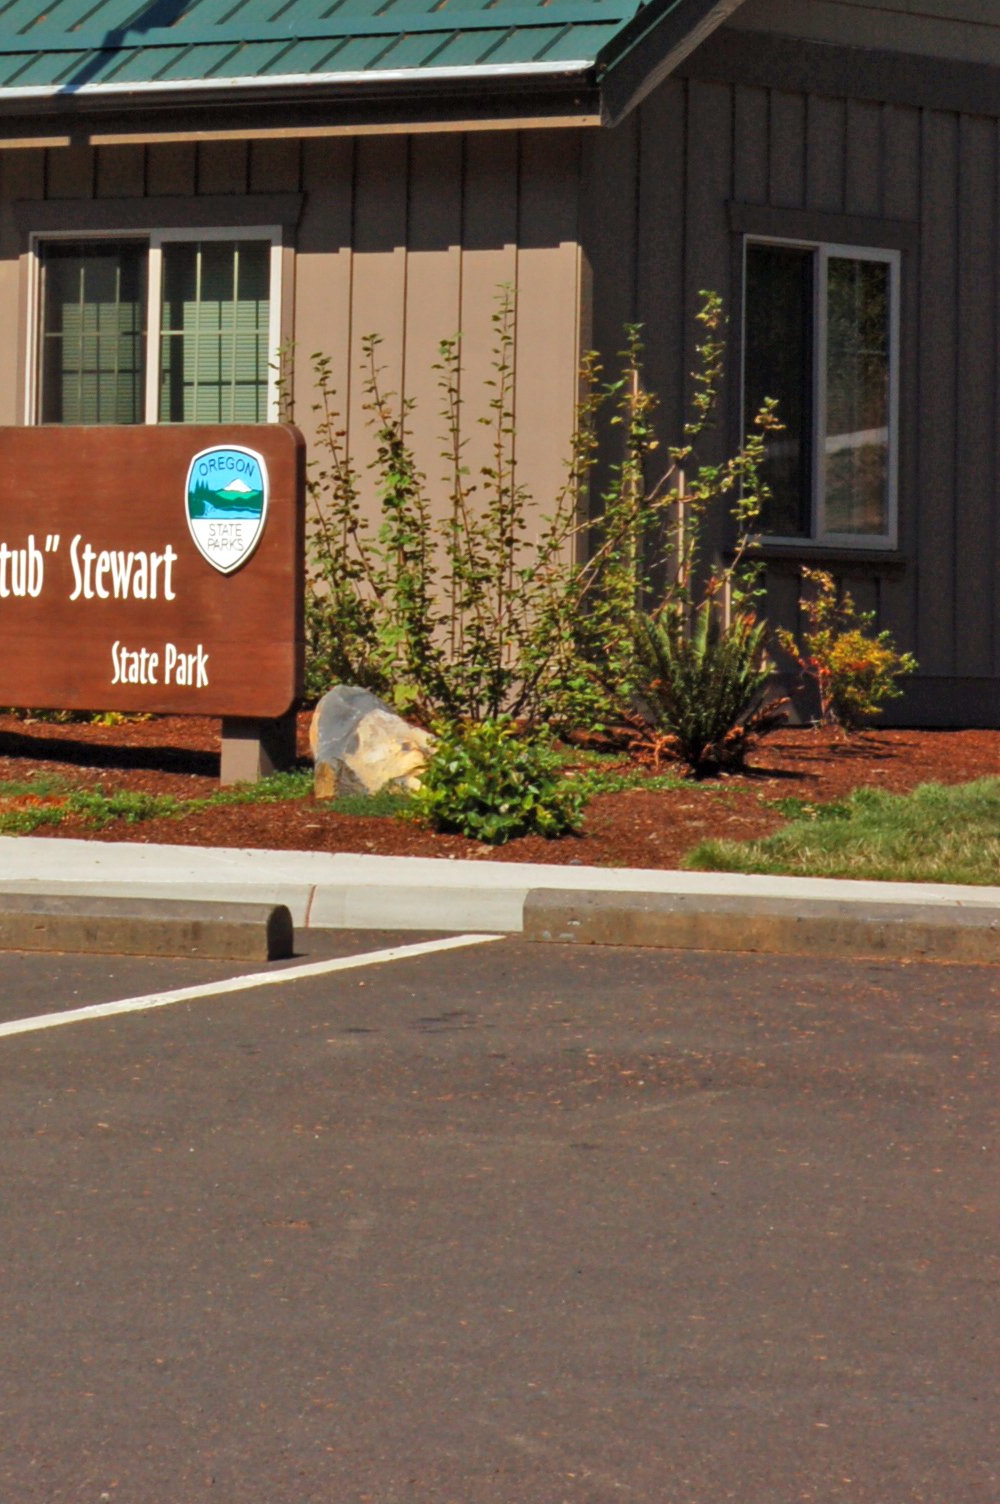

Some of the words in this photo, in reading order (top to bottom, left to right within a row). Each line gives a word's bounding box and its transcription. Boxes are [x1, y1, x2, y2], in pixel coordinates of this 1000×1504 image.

[199, 456, 255, 477] OREGON
[209, 523, 242, 537] STATE
[207, 538, 244, 552] PARKS
[69, 534, 178, 601] Stewart
[111, 640, 158, 686] State
[164, 643, 209, 689] Park
